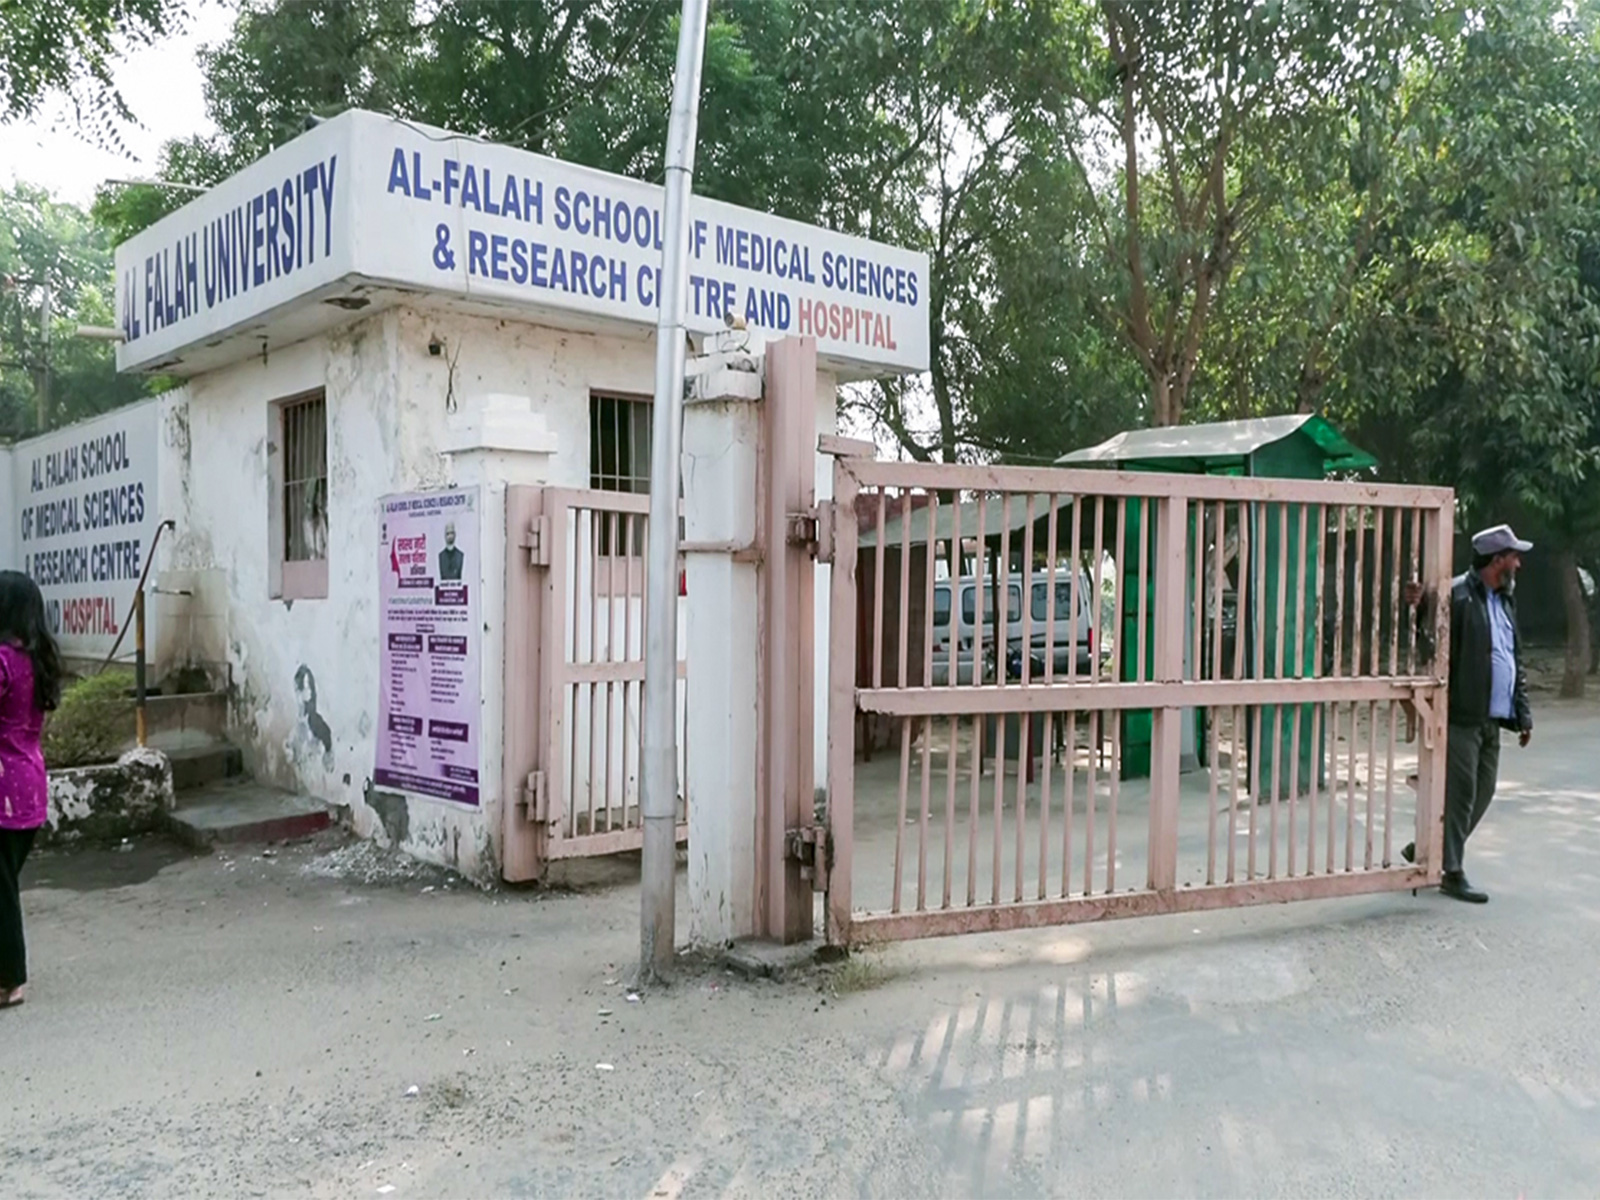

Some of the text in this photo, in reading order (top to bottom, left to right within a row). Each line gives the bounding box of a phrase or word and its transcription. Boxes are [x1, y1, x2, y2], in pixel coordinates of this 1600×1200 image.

[122, 154, 337, 342] AL FALAH UNIVERSITY
[387, 147, 918, 307] AL-FALAH SCHOOL F MEDICAL SCIENCES
[432, 223, 456, 271] &
[468, 230, 627, 302] RESEARCH
[744, 286, 791, 331] AND
[798, 297, 897, 351] HOSPITAL
[31, 430, 129, 493] AL FALAH SCHOOL
[21, 482, 144, 541] OF MEDICAL SCIENCES
[33, 546, 88, 586] RESEARCH
[90, 539, 140, 582] CENTRE
[45, 597, 118, 635] ND HOSPITAL
